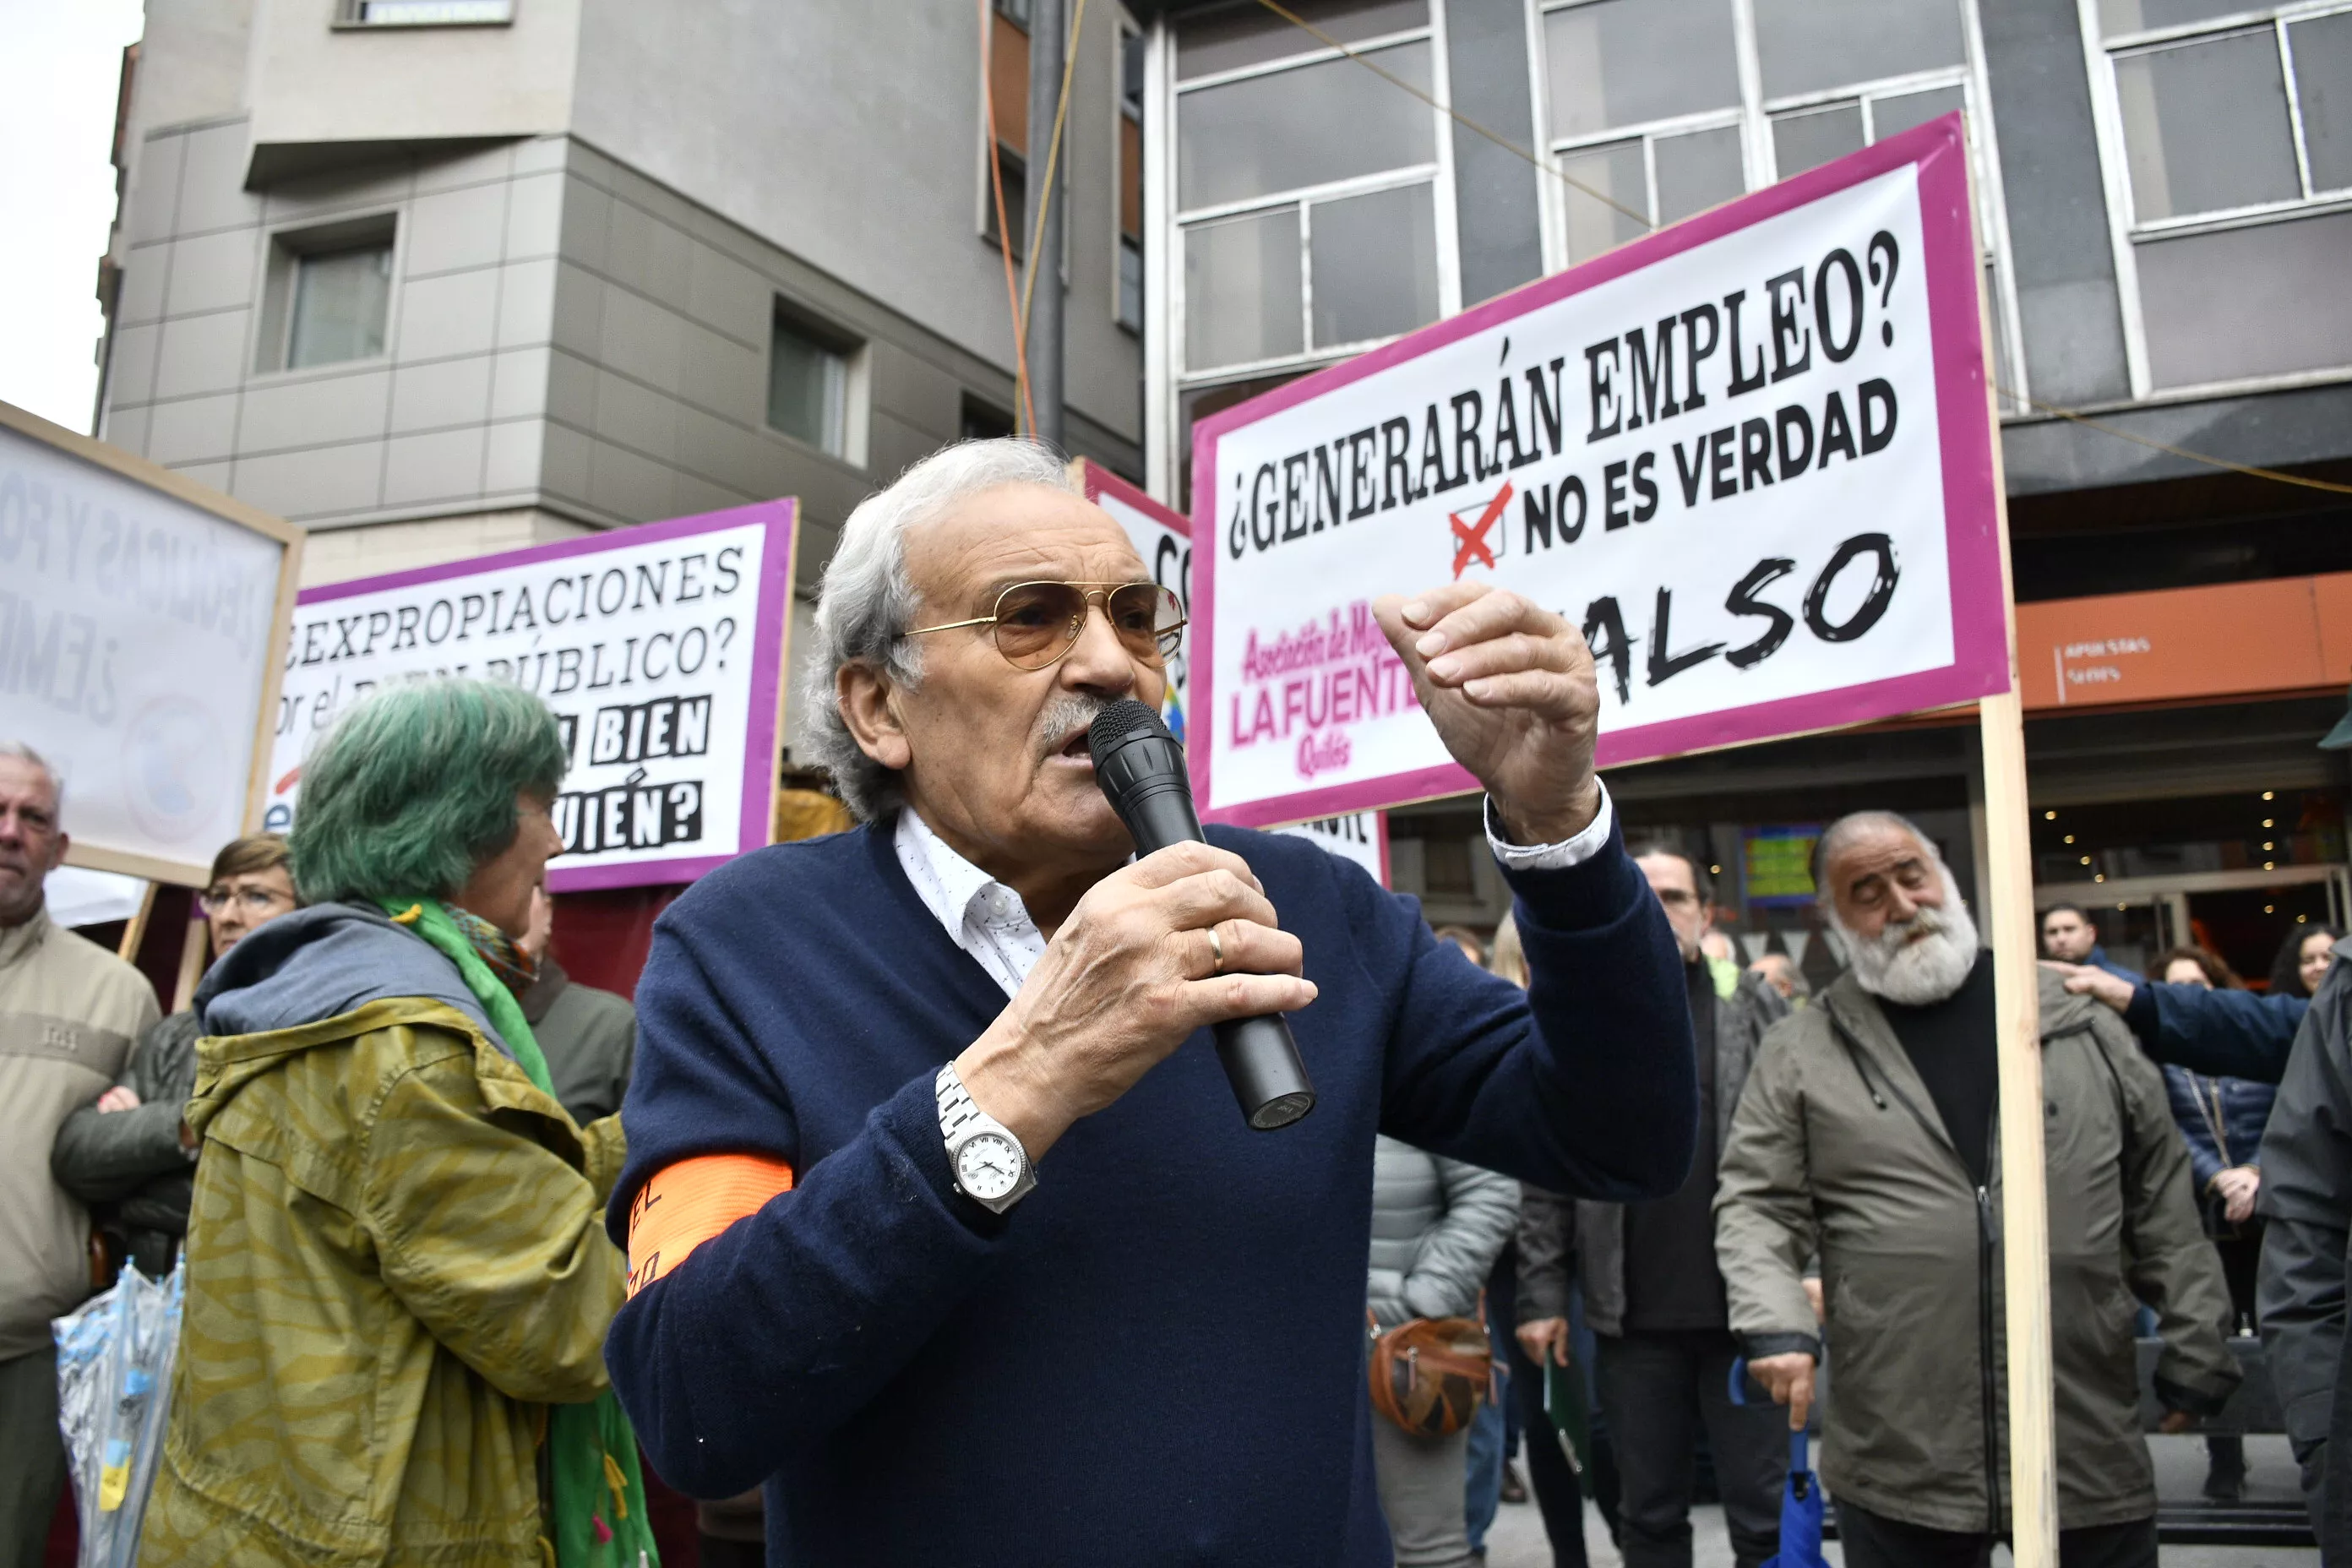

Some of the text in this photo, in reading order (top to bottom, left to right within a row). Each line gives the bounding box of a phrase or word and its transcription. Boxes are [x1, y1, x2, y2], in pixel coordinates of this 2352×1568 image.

[1229, 229, 1899, 560] ¿GENERARÁN EMPLEO?
[1523, 377, 1899, 555] NO ES VERDAD
[1560, 531, 1902, 706] ALSO
[591, 695, 712, 765] BIEN
[1231, 688, 1277, 749] LA
[551, 766, 703, 854] UIÉN?
